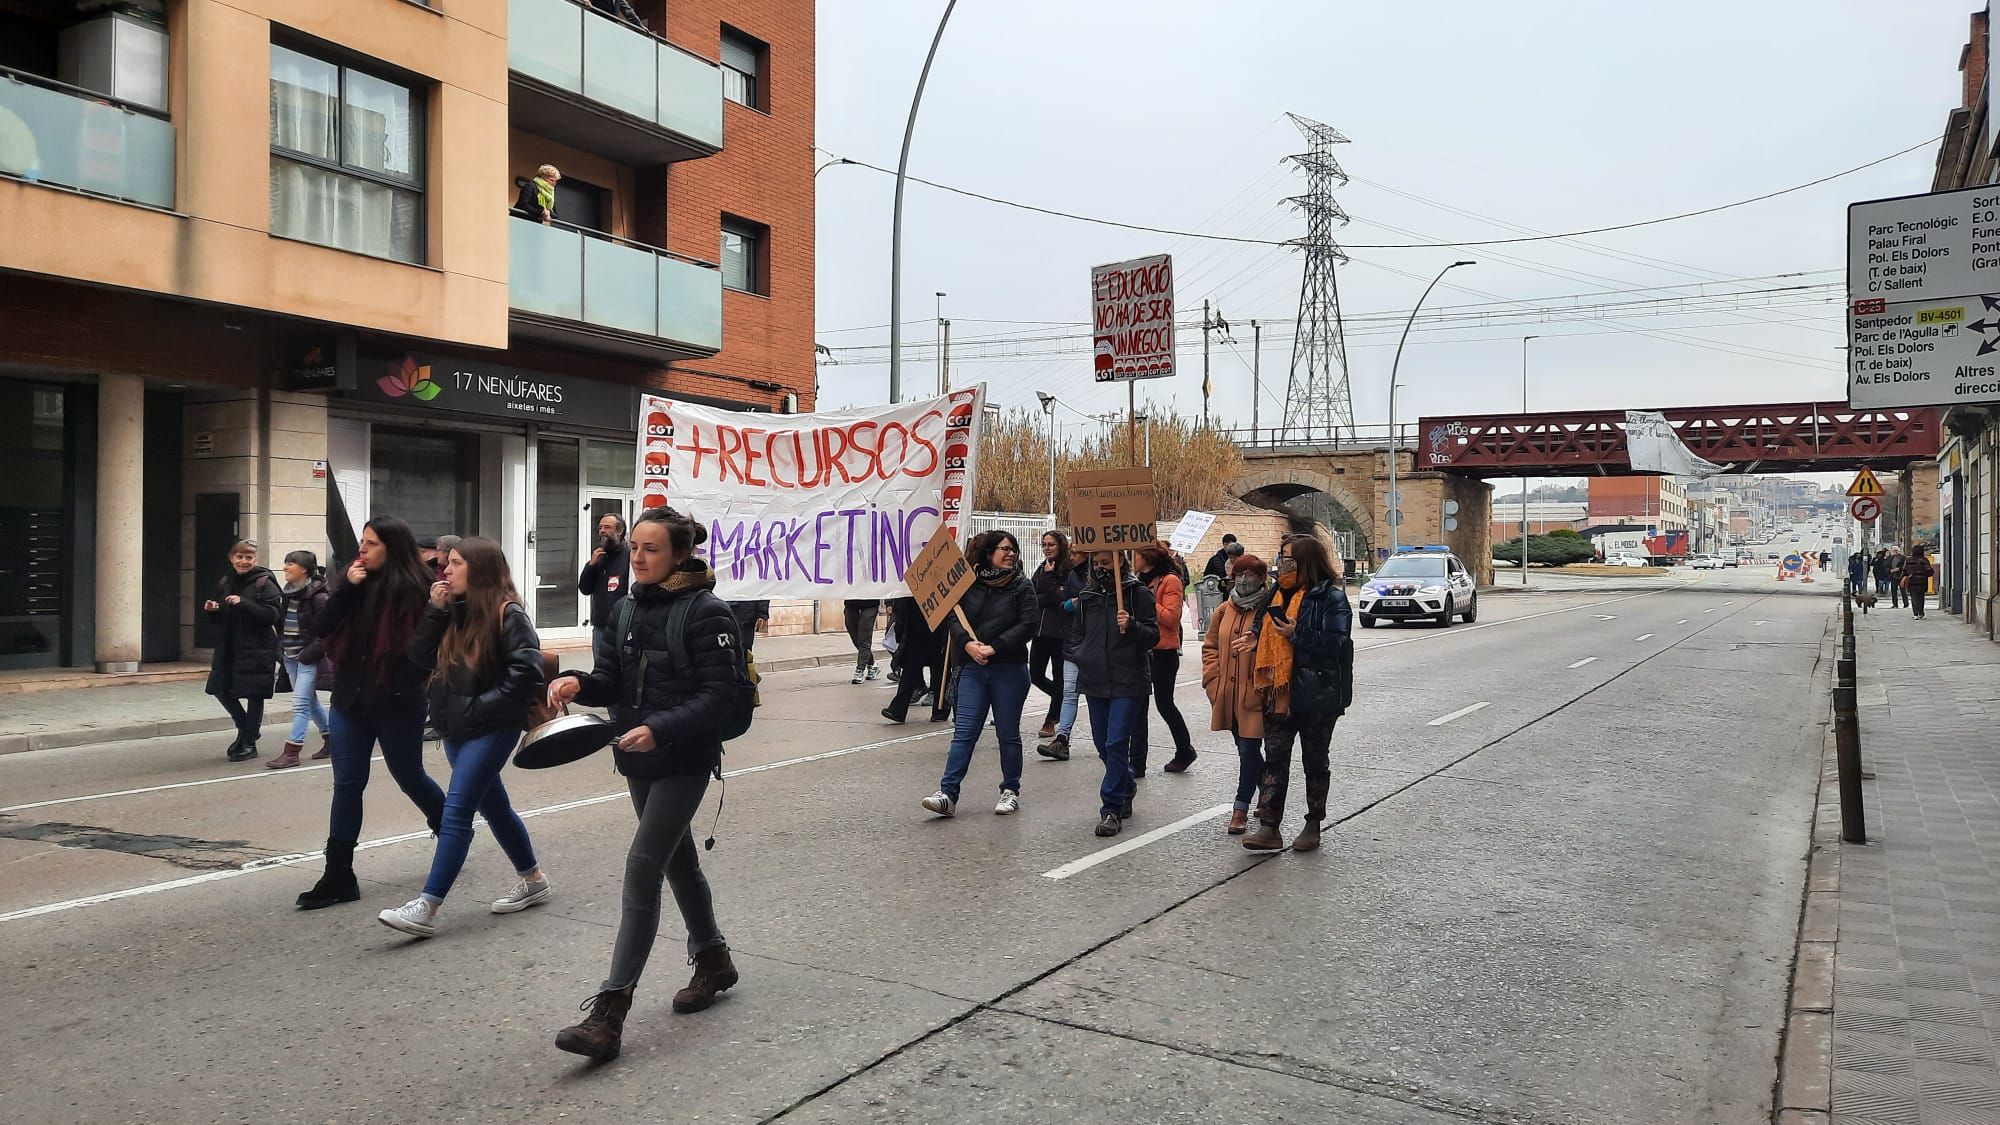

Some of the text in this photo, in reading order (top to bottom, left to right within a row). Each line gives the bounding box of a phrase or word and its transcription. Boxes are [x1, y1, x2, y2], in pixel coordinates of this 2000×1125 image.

[1972, 210, 1998, 224] E.O.
[1868, 215, 1959, 236] Parc Tecnológic
[1868, 233, 1926, 250] Palau Firal
[1868, 246, 1950, 264] Pol. Els Dolors
[1868, 261, 1927, 280] (T. de baix)
[1868, 277, 1923, 292] C/ Sallent
[1096, 298, 1172, 331] NO HA DE SER
[1858, 301, 1881, 313] C-25
[1854, 314, 1913, 330] Santpedor
[1920, 310, 1962, 322] BV-4501
[1854, 326, 1939, 343] Parc de l'Agulla
[1114, 332, 1128, 356] UN
[1854, 341, 1935, 357] Pol. Els Dolors
[1854, 356, 1913, 373] (T. de baix)
[1954, 365, 1995, 379] Altres
[1095, 369, 1113, 380] CGT
[1855, 371, 1931, 385] Av. Els Dolors
[453, 371, 563, 403] 17 NENÚFARES
[947, 415, 972, 426] CGT
[648, 425, 674, 435] CGT
[645, 465, 669, 474] CGT
[1074, 526, 1096, 544] NO
[1614, 540, 1638, 550] EL MOSCA
[922, 591, 940, 618] FOT
[936, 581, 950, 599] EL
[946, 557, 968, 587] CAMP
